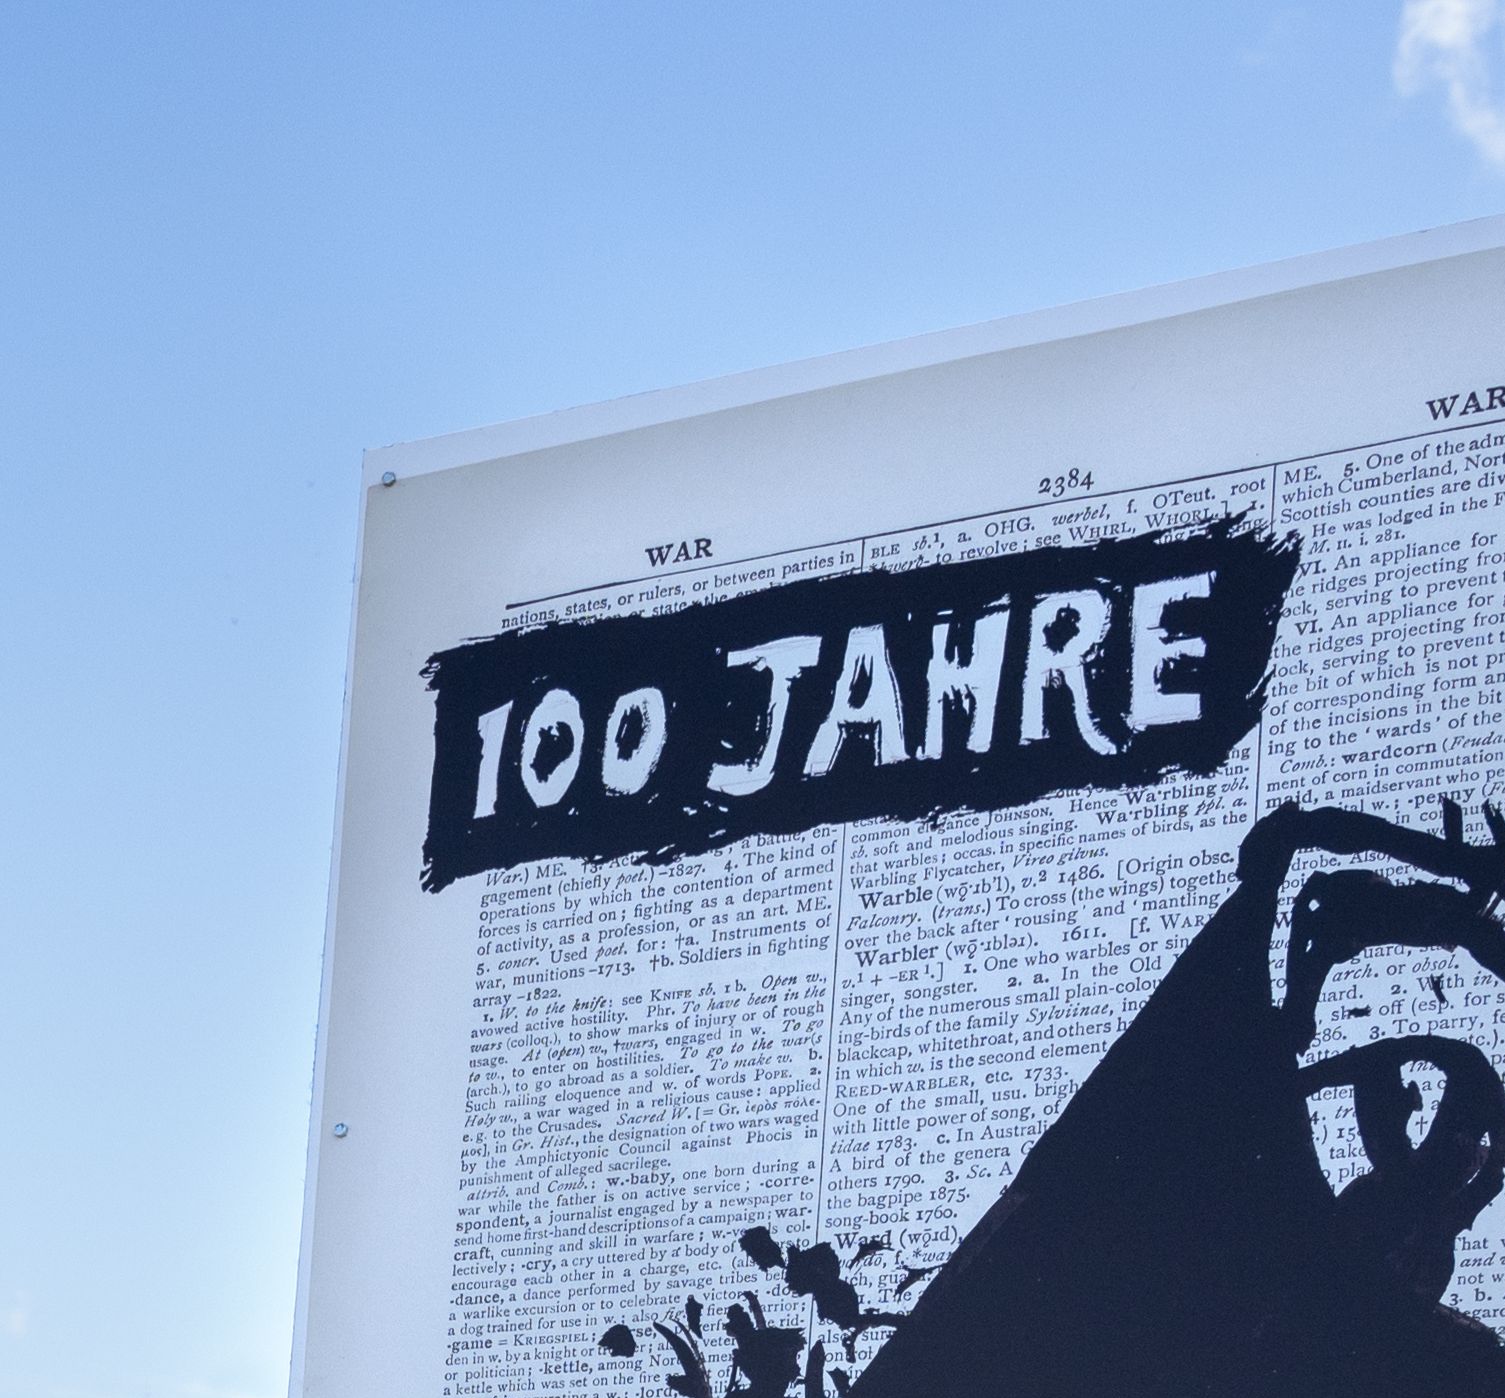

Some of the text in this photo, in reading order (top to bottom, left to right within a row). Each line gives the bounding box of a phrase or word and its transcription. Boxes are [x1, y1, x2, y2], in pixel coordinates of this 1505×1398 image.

[1036, 466, 1095, 498] 2384
[1281, 480, 1334, 505] which
[1336, 458, 1458, 494] Cumberland,
[1282, 463, 1322, 486] ME.
[1342, 460, 1360, 478] 5.
[1365, 452, 1404, 470] One
[1409, 442, 1431, 462] of
[1434, 439, 1465, 457] the
[1279, 496, 1352, 525] Scottish
[1357, 483, 1435, 510] counties
[1440, 478, 1472, 495] are
[643, 536, 714, 568] WAR
[1293, 617, 1324, 636] VI.
[1329, 612, 1358, 631] An
[1365, 599, 1458, 627] appliance
[1466, 591, 1495, 609] for
[474, 571, 1217, 819] 100 JAHRE
[478, 856, 834, 925] operations by which the contention of armed
[849, 845, 1109, 891] Warbling Flycatcher, Vireo gilvus.
[475, 895, 832, 957] of activity, as a profession, or as an art. ME.
[853, 942, 939, 968] Warbler
[834, 1038, 1108, 1081] in which w. is the second element
[458, 1155, 672, 1191] punishment of alleged sacrilege.
[459, 1127, 818, 1175] by the Amphictyonic Council against Phocis in
